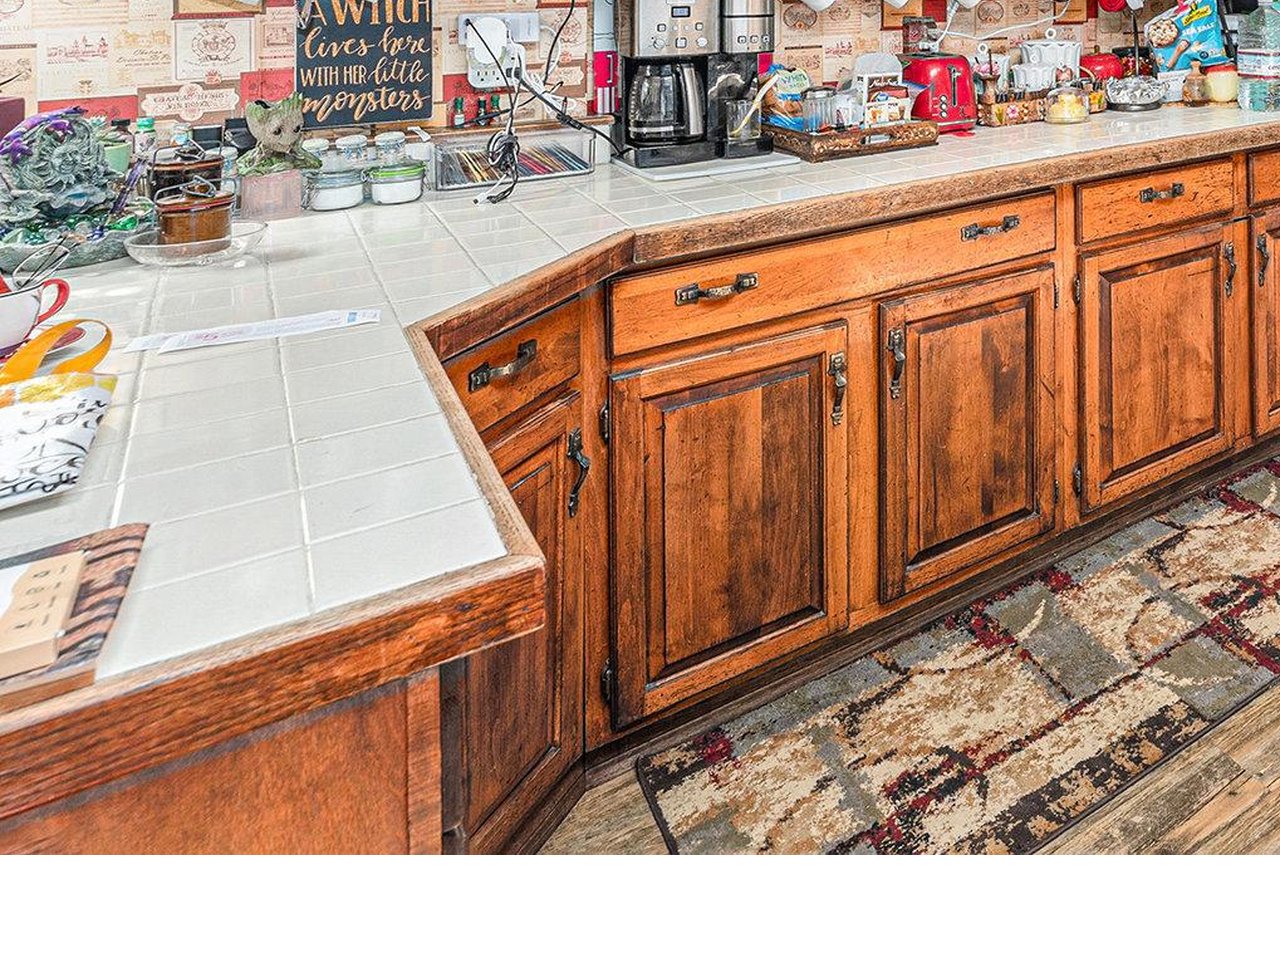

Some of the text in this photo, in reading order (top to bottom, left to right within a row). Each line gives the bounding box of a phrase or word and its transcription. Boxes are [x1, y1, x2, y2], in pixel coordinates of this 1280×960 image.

[299, 25, 431, 59] lives here
[301, 56, 429, 87] WITH HER little
[302, 86, 431, 122] monsters
